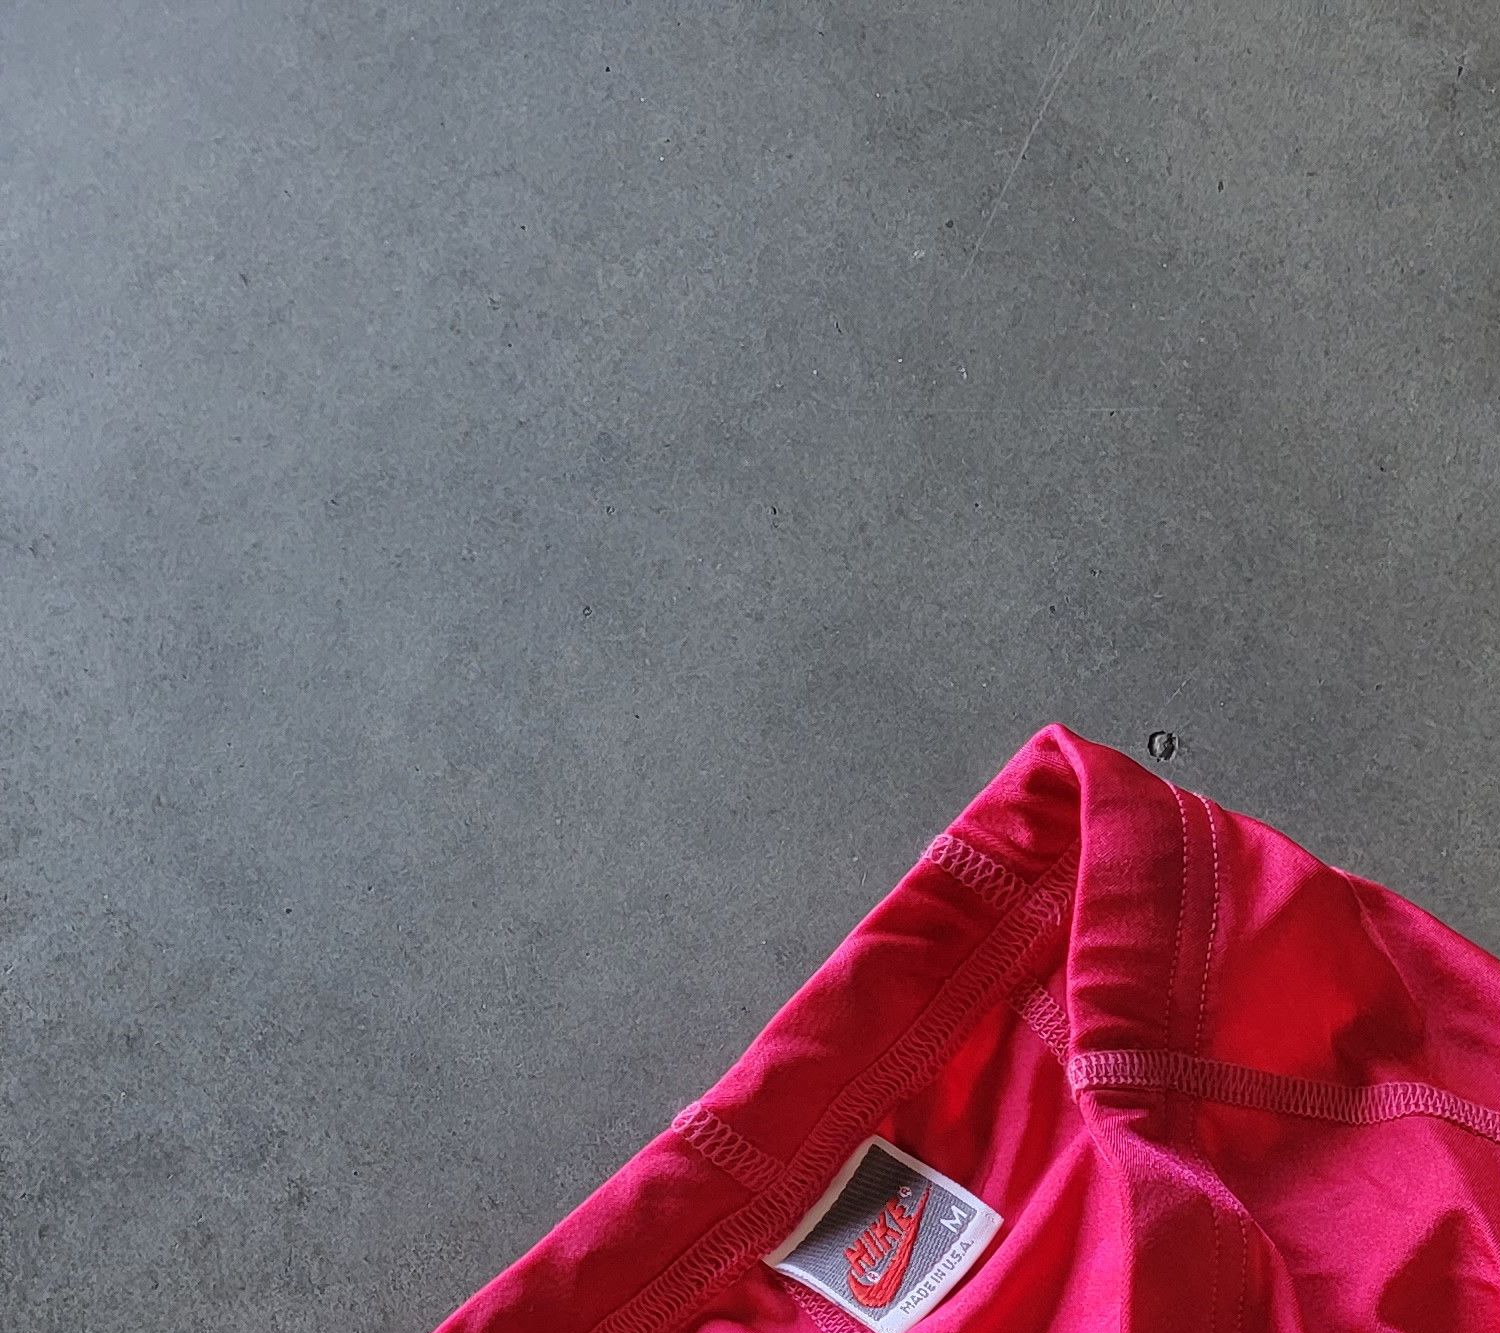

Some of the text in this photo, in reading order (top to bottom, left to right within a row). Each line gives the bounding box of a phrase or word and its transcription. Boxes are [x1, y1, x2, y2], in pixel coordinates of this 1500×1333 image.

[843, 1196, 912, 1277] NIKE
[940, 1205, 968, 1234] M
[899, 1281, 937, 1315] MADE
[930, 1268, 947, 1284] IN
